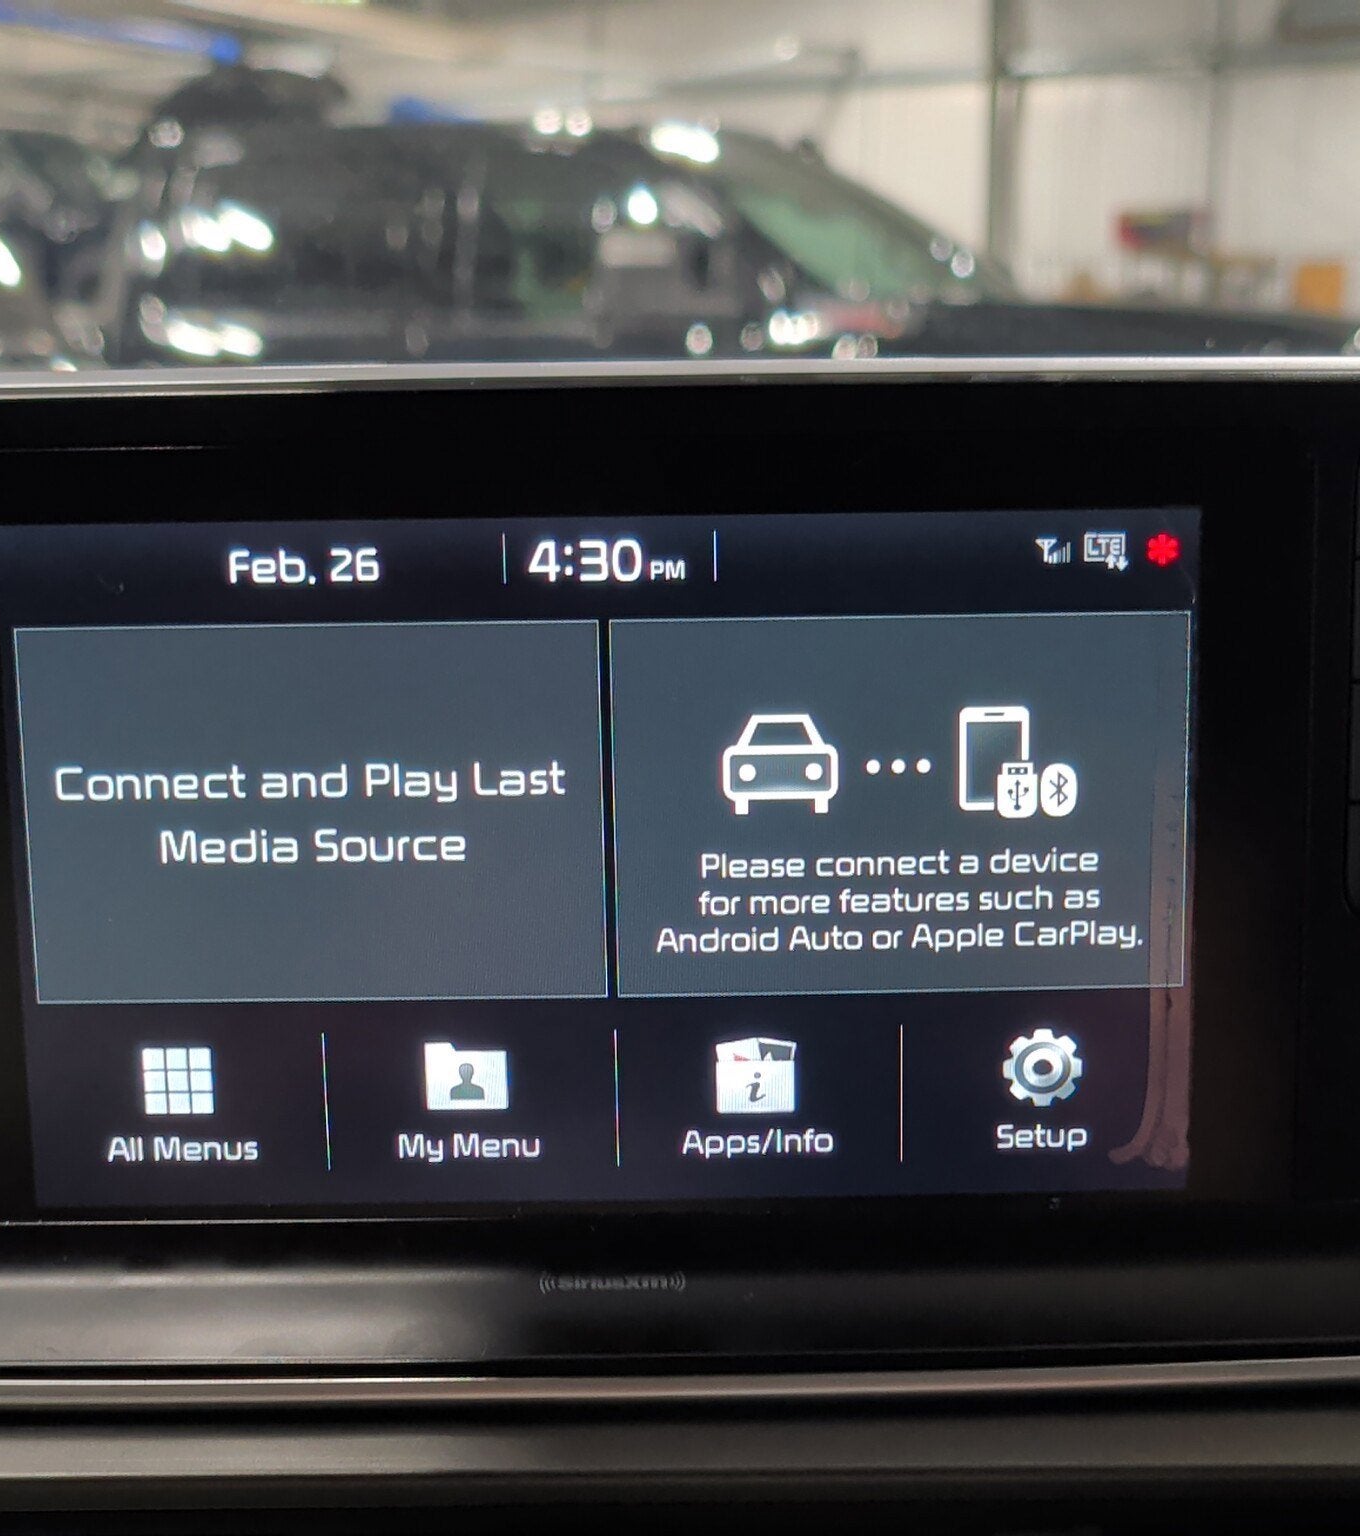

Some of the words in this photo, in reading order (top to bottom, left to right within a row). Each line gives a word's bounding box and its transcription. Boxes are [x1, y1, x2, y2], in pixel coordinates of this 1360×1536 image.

[528, 537, 643, 583] 4:30
[649, 559, 686, 581] PM
[1088, 536, 1121, 558] LTE
[228, 547, 317, 585] Feb.
[329, 546, 380, 582] 26
[55, 764, 247, 801] Connect
[261, 763, 348, 799] and
[365, 762, 458, 803] Play
[473, 760, 566, 797] Last
[160, 828, 299, 864] Media
[314, 828, 466, 863] Source
[701, 852, 806, 879] Please
[815, 849, 951, 877] connect
[958, 854, 980, 874] a
[989, 846, 1099, 874] device
[698, 890, 741, 916] for
[749, 894, 831, 915] more
[838, 887, 970, 914] features
[979, 884, 1053, 911] such
[1063, 889, 1101, 909] as
[656, 926, 780, 954] Android
[789, 925, 863, 952] Auto
[872, 930, 904, 950] or
[911, 922, 1005, 953] Apple
[1014, 920, 1143, 949] CarPlay.
[107, 1136, 145, 1163] All
[153, 1136, 259, 1162] Menus
[398, 1133, 444, 1163] My
[452, 1132, 541, 1159] Menu
[682, 1127, 834, 1159] Apps/Info
[996, 1123, 1088, 1152] Setup
